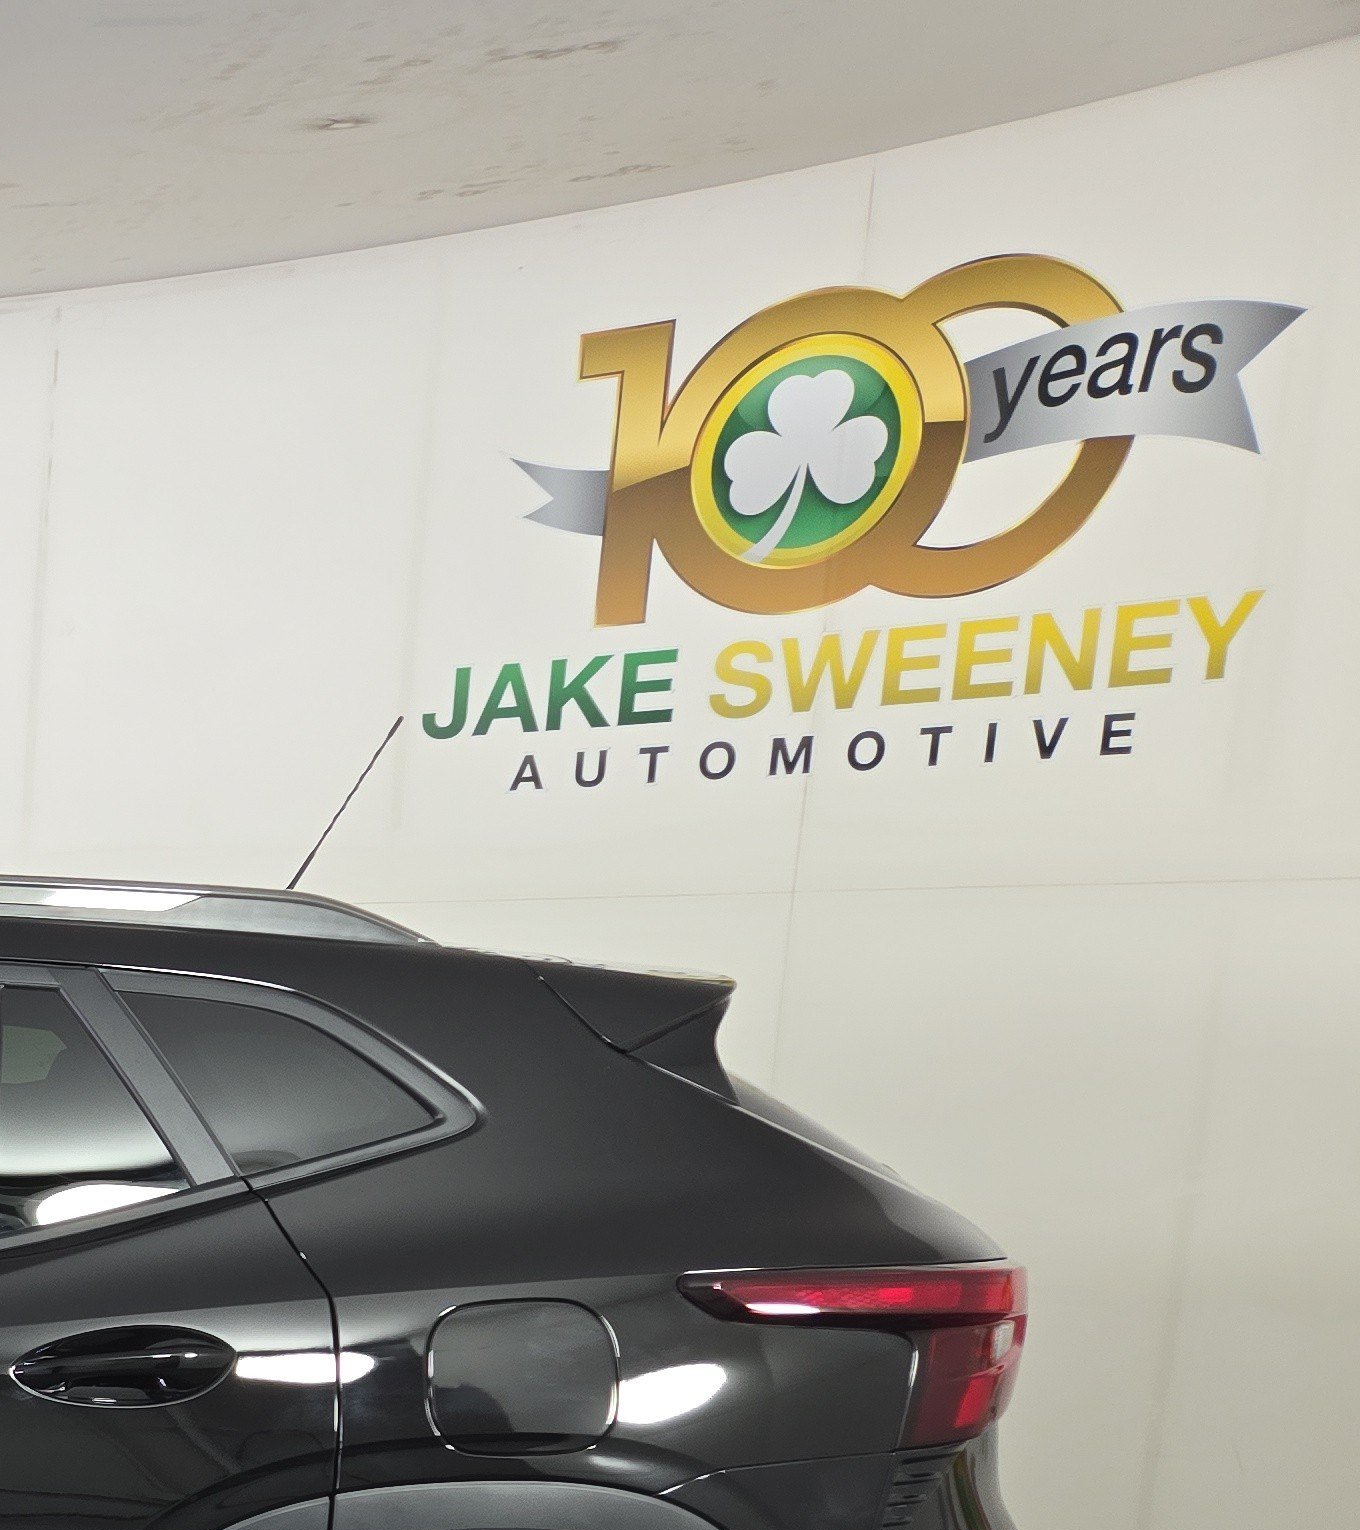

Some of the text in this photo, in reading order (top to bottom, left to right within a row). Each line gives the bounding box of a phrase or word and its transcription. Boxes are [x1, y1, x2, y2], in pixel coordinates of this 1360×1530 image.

[983, 322, 1225, 445] years
[420, 588, 1269, 741] JAKE SWEENEY
[509, 711, 1138, 793] AUTOMOTIVE
